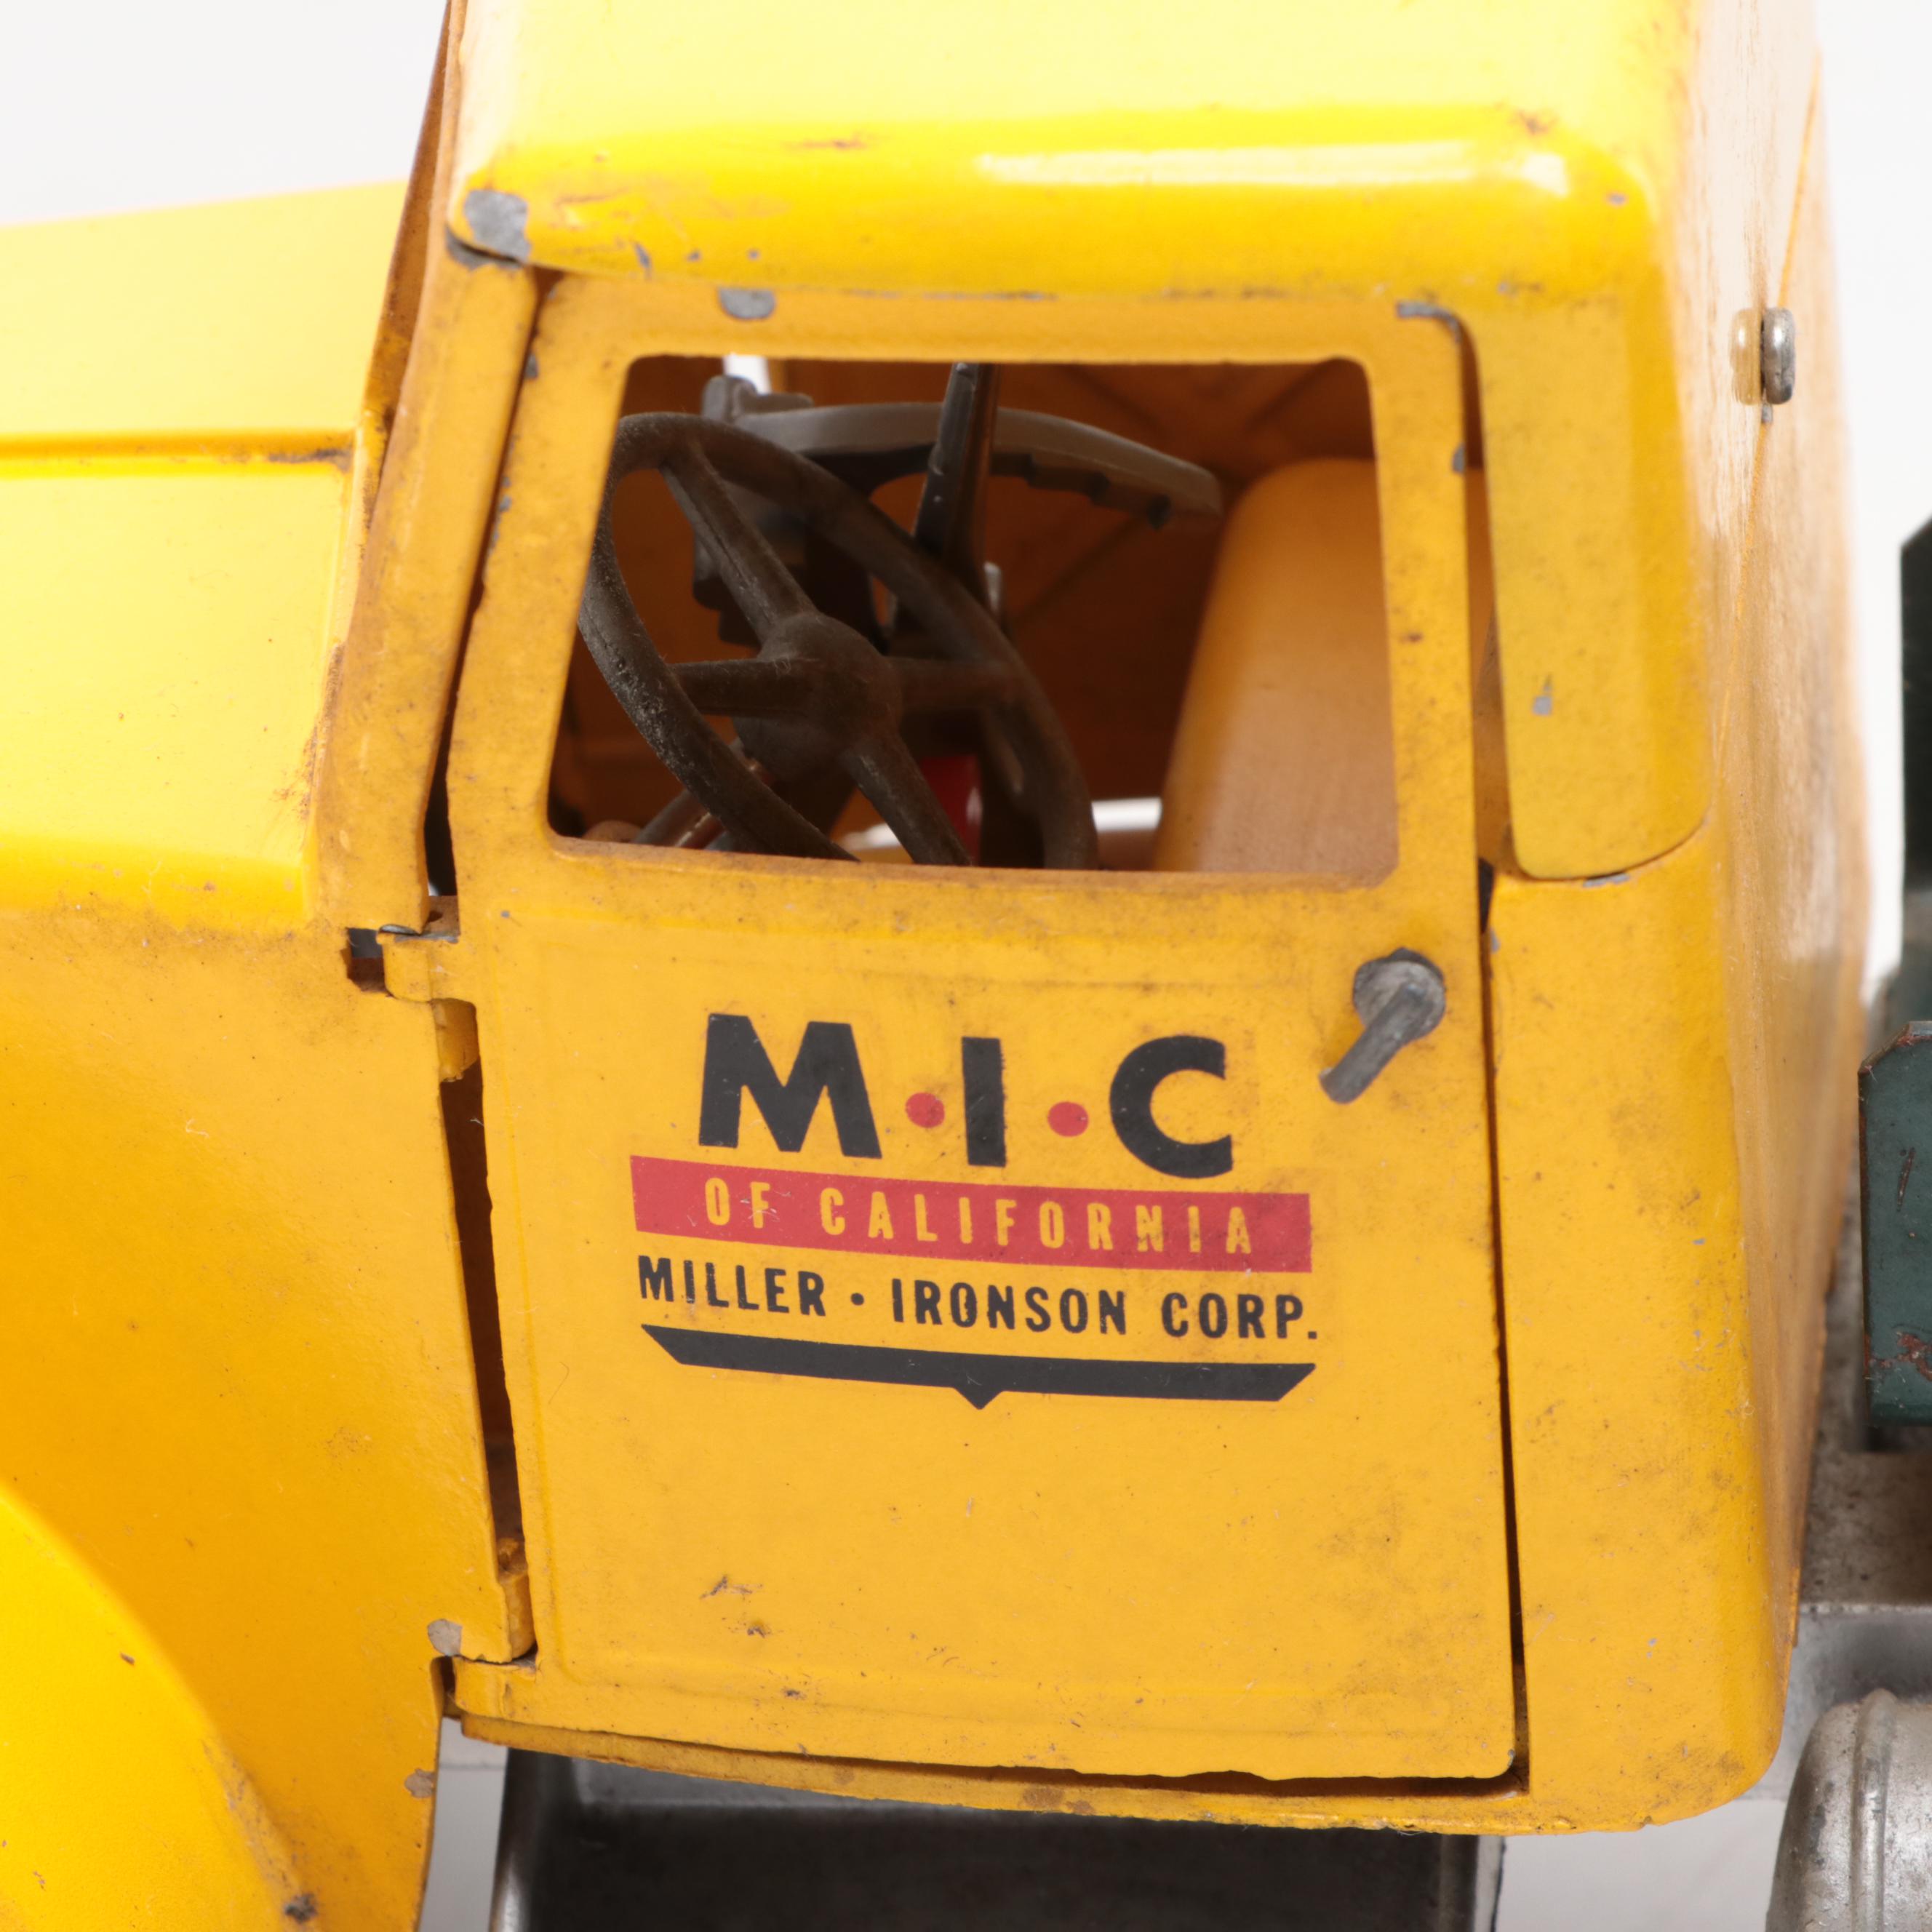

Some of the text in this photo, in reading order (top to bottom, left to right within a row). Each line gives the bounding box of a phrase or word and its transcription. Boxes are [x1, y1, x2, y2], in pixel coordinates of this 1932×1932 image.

[705, 1177, 1253, 1255] OF CALIFORNIA
[637, 1256, 1318, 1340] MILLER IRONSON CORP.
